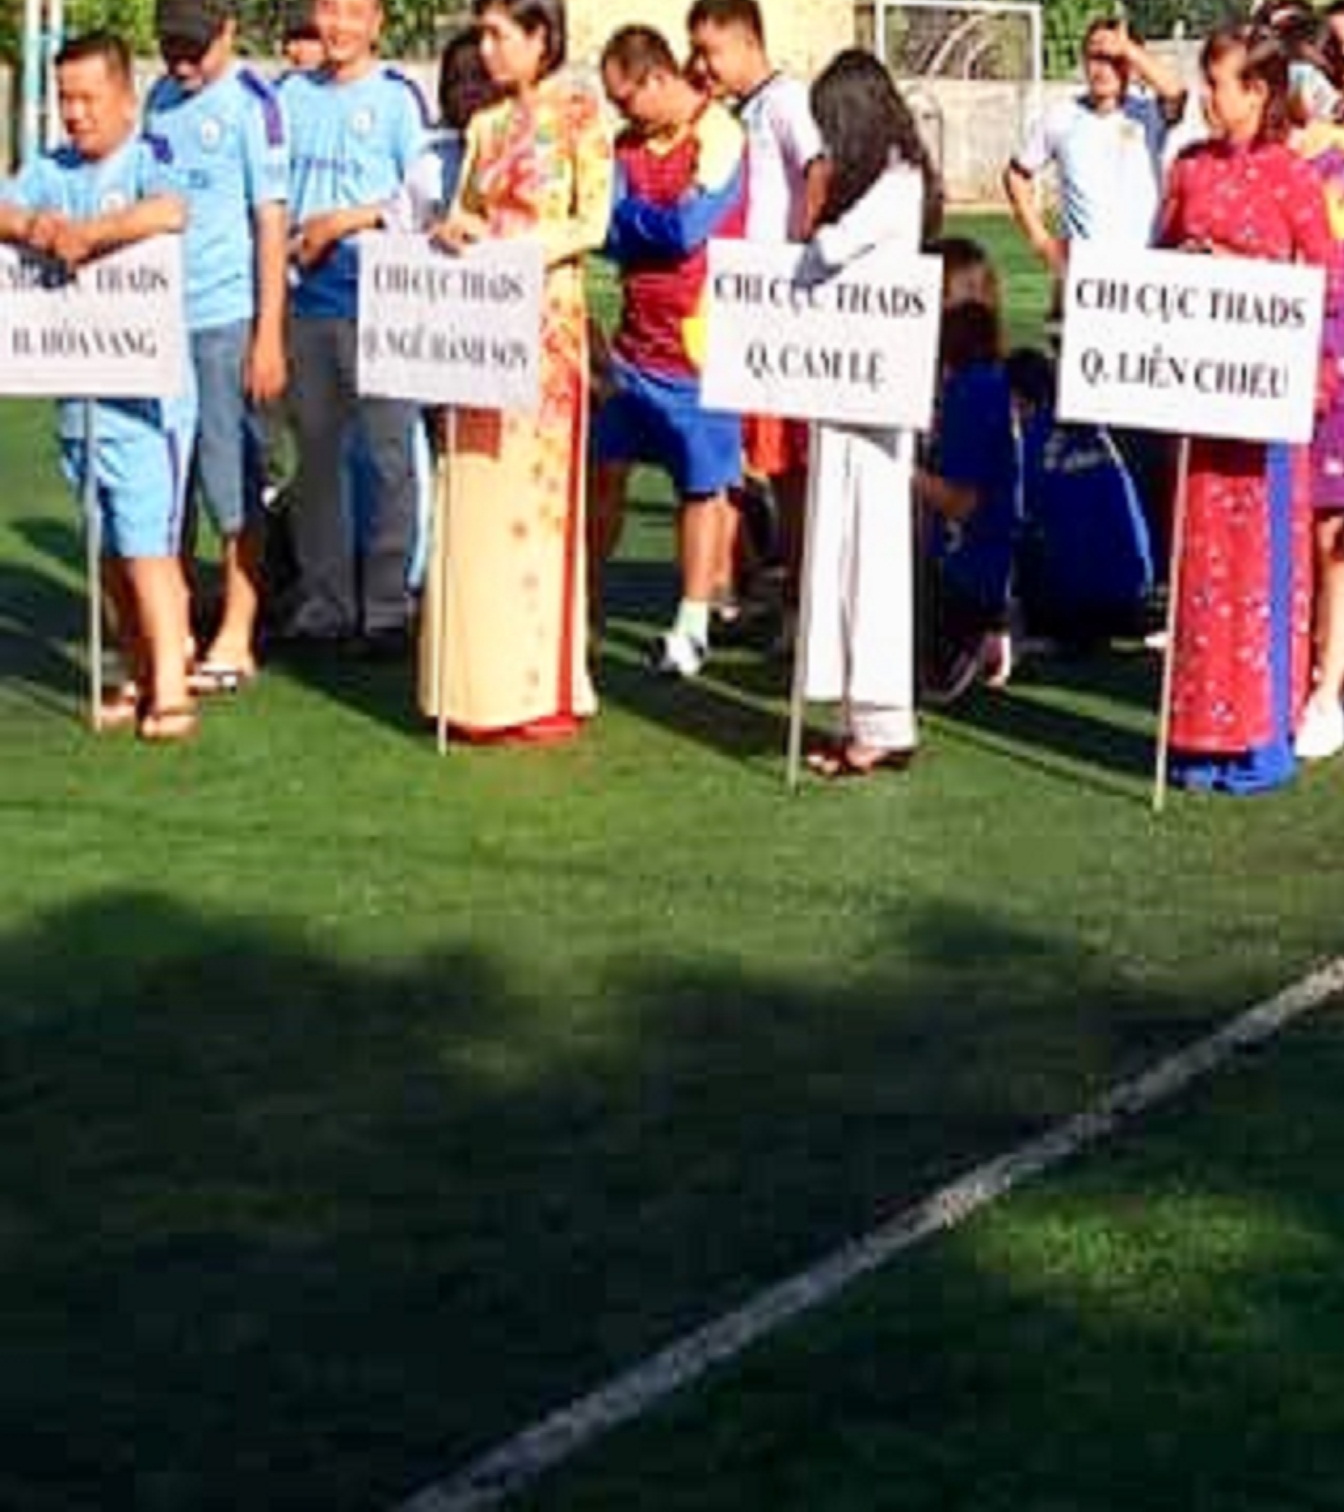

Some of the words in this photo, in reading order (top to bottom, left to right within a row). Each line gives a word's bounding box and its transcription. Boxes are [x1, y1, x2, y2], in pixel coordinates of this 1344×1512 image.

[714, 272, 763, 304] CHI
[836, 283, 926, 318] THADS
[1075, 278, 1129, 313] CHI
[1135, 283, 1197, 323] CỤC
[1208, 288, 1308, 328] THADS
[1080, 347, 1111, 388] Q.
